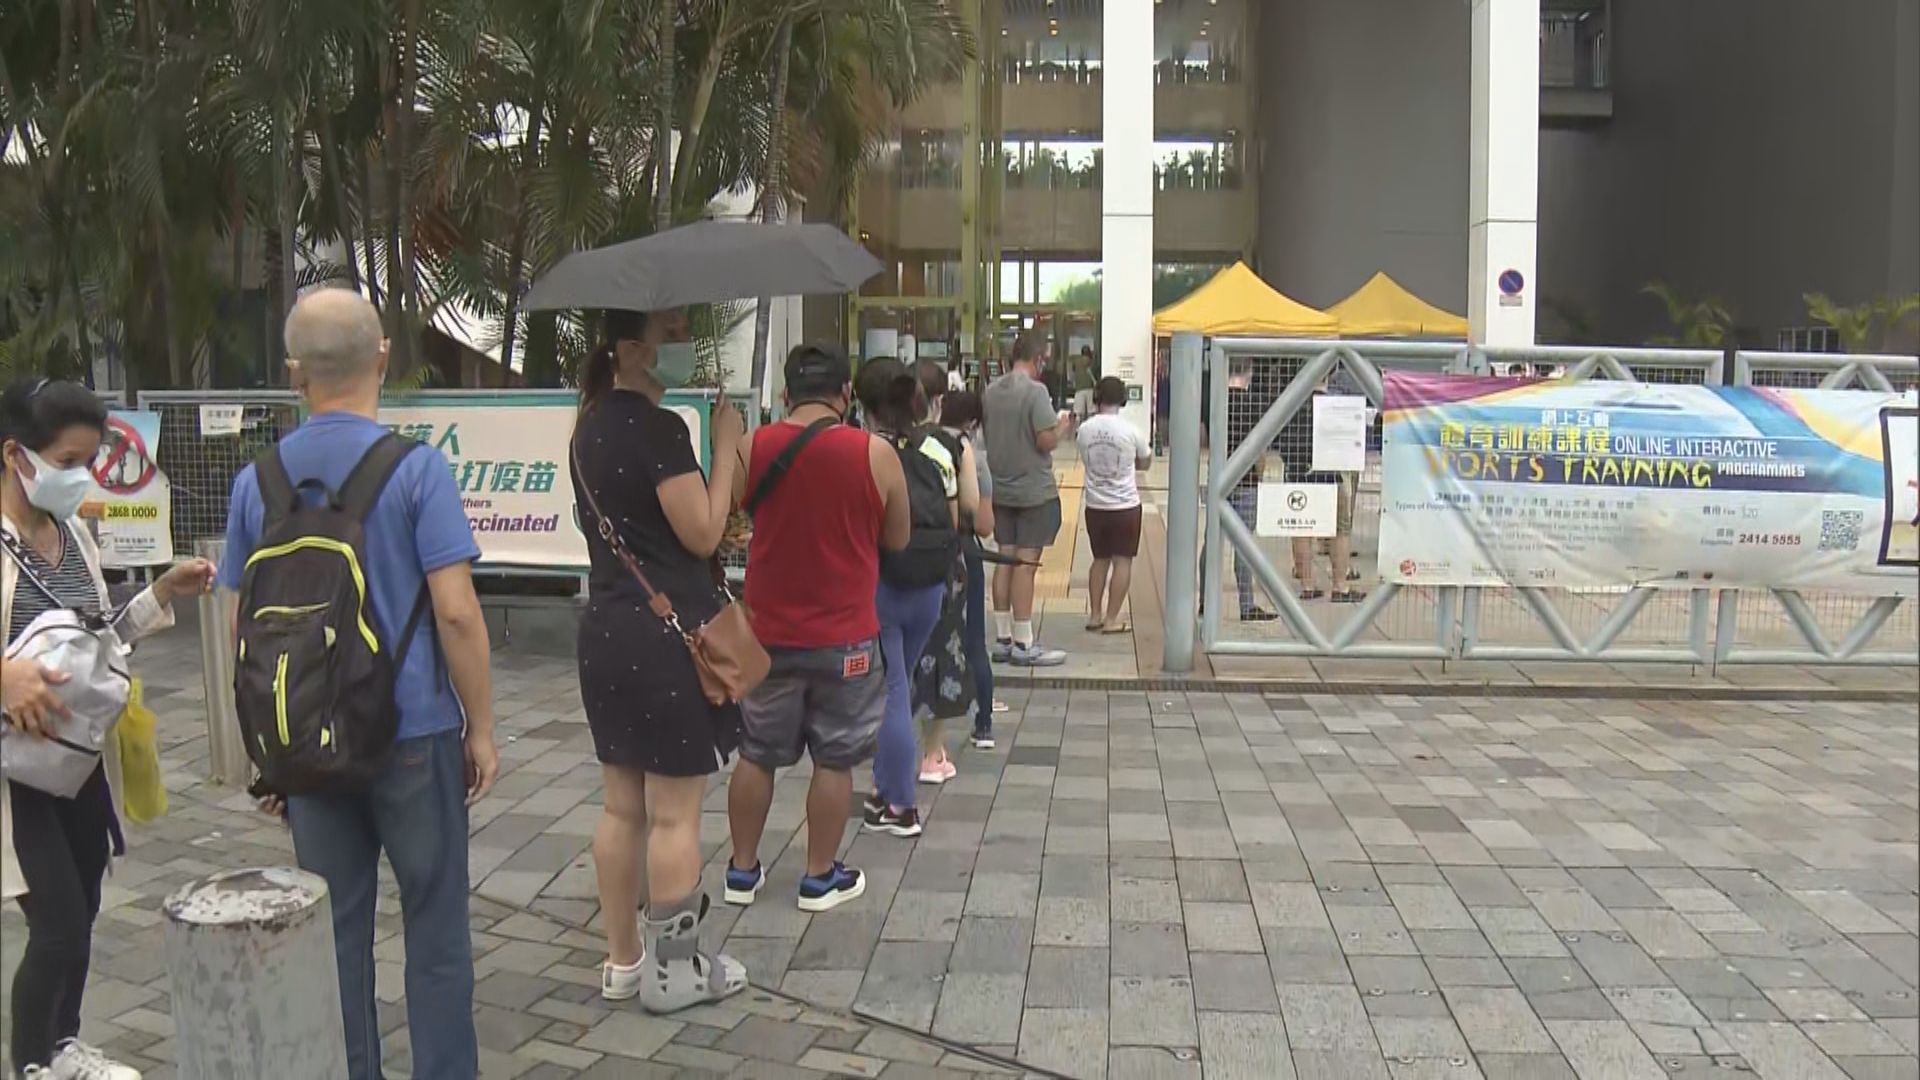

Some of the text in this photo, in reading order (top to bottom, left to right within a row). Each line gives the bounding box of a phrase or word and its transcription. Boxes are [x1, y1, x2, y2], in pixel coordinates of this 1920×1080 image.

[1615, 435, 1778, 458] ONLINE INTERACTIVE
[449, 460, 558, 493] 打疫苗
[1554, 454, 1712, 488] TRAINING
[1717, 461, 1806, 478] PROGRAMMES
[107, 505, 157, 518] 2868 0000
[1738, 533, 1769, 546] 2414
[1771, 534, 1802, 546] 5555
